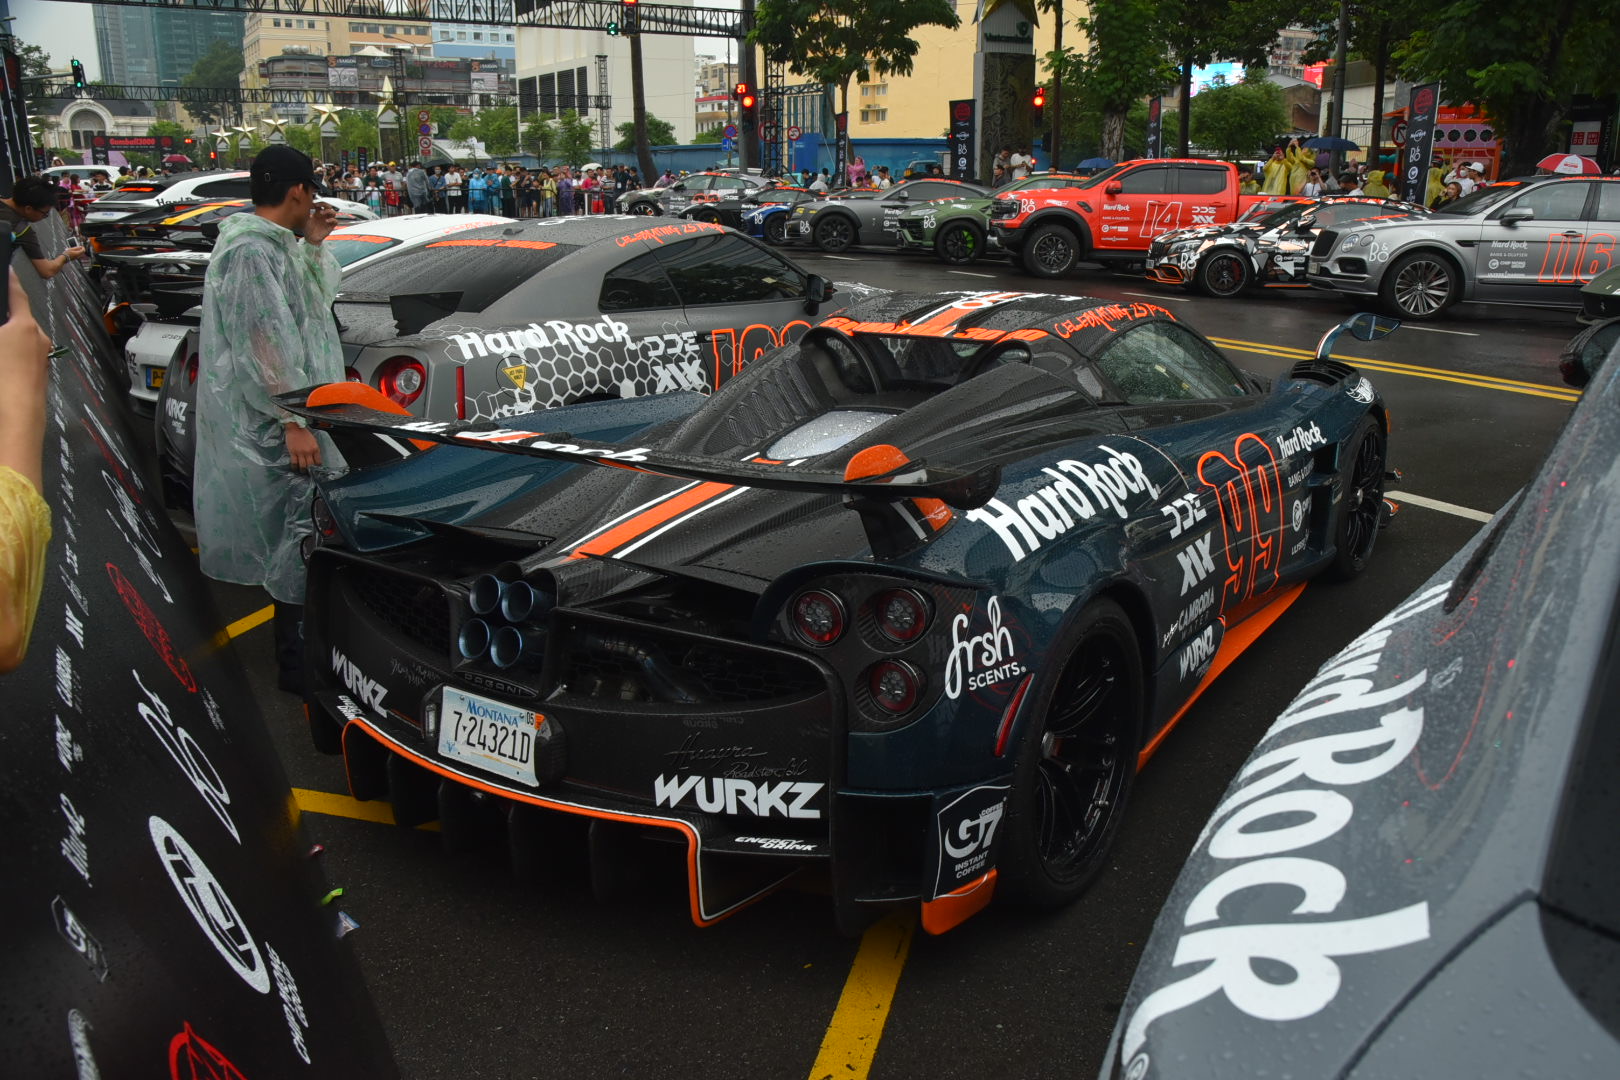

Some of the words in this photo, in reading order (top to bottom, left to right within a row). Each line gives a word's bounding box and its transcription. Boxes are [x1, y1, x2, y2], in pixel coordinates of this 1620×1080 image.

[447, 323, 551, 360] Hard
[545, 315, 637, 356] Rock
[1276, 427, 1300, 459] Hard
[1297, 420, 1327, 452] Rock
[965, 467, 1096, 562] Hard
[1055, 444, 1164, 519] Rock
[1178, 586, 1215, 632] CAMBODIA
[944, 595, 1015, 700] frsh
[1179, 624, 1215, 682] WURKZ
[332, 645, 388, 719] WURKZ
[968, 661, 1021, 691] SCENTS
[466, 699, 519, 728] MONTANA
[526, 711, 535, 726] 05
[654, 773, 826, 819] WURKZ
[735, 836, 804, 846] ENERGY
[759, 841, 818, 851] DRINK
[955, 850, 989, 872] INSTANT
[956, 860, 986, 879] COFFEE
[1122, 707, 1431, 1067] Rock
